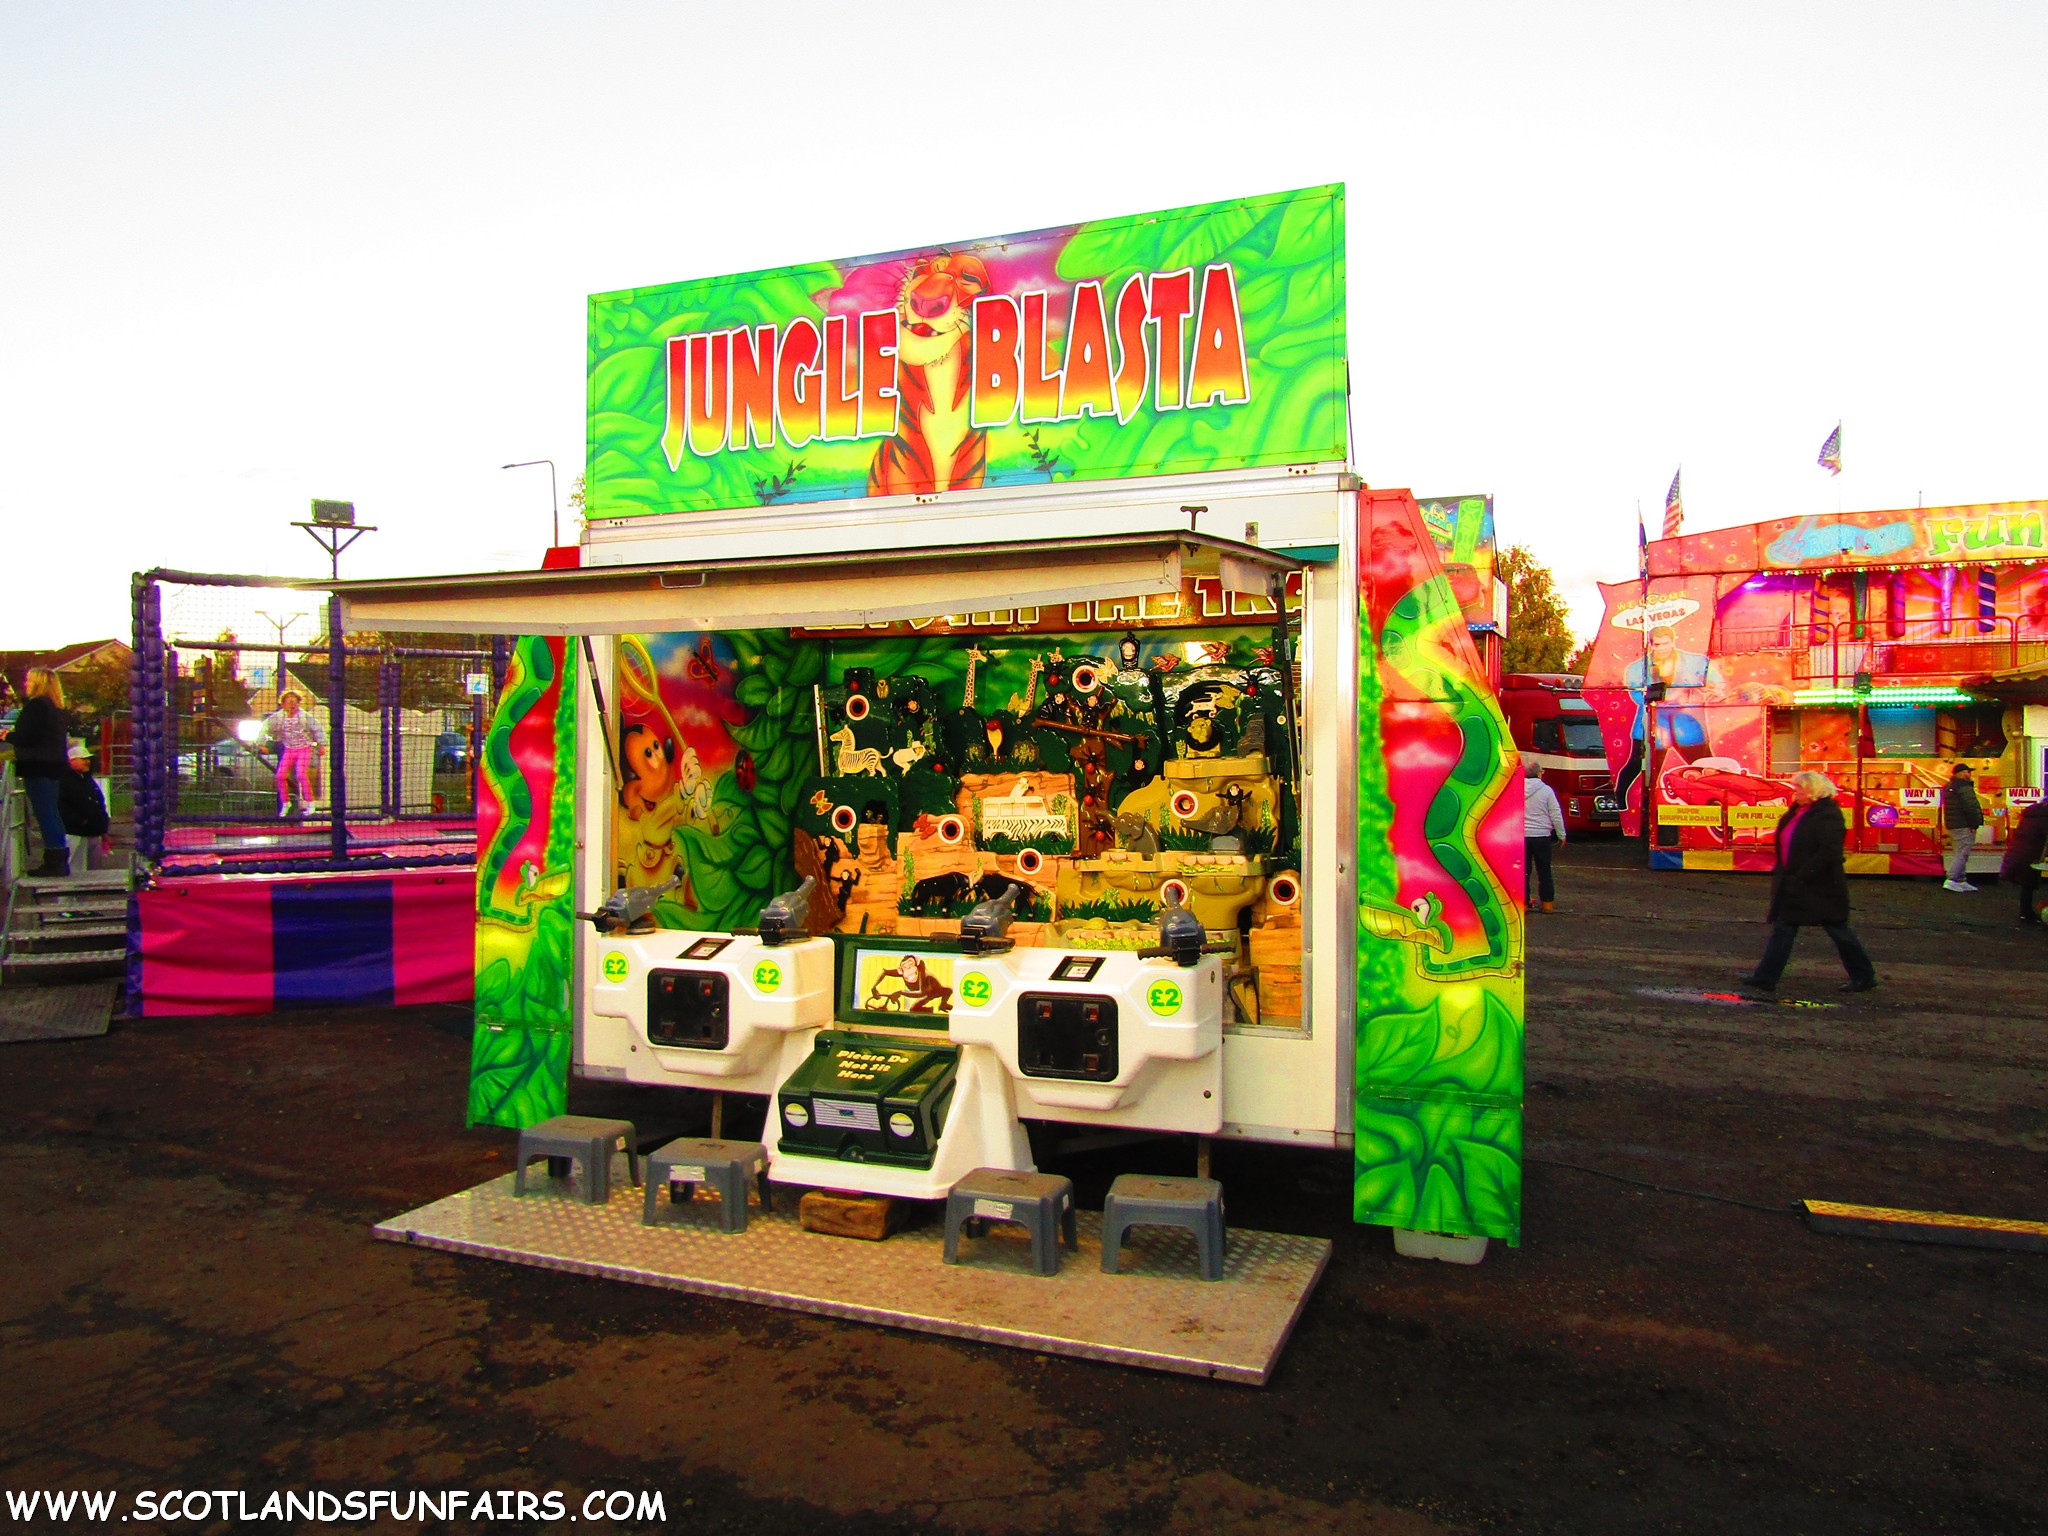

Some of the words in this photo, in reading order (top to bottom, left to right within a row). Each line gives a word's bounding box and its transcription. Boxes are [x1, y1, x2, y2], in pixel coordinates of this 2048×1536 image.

[661, 308, 900, 472] JUNGLE
[971, 262, 1250, 428] BLASTA
[1626, 615, 1645, 627] LAS
[1648, 607, 1686, 622] VEGAS
[1904, 789, 1924, 798] WAY
[1926, 789, 1935, 798] IN
[2009, 788, 2028, 798] WAY
[2031, 788, 2041, 798] IN
[605, 959, 627, 975] £2
[756, 967, 780, 985] £2
[962, 979, 990, 999] £2
[1149, 987, 1180, 1008] £2
[836, 1049, 886, 1062] Please
[887, 1054, 909, 1064] Do
[838, 1060, 868, 1071] Not
[869, 1062, 891, 1072] Sit
[836, 1069, 875, 1081] Here
